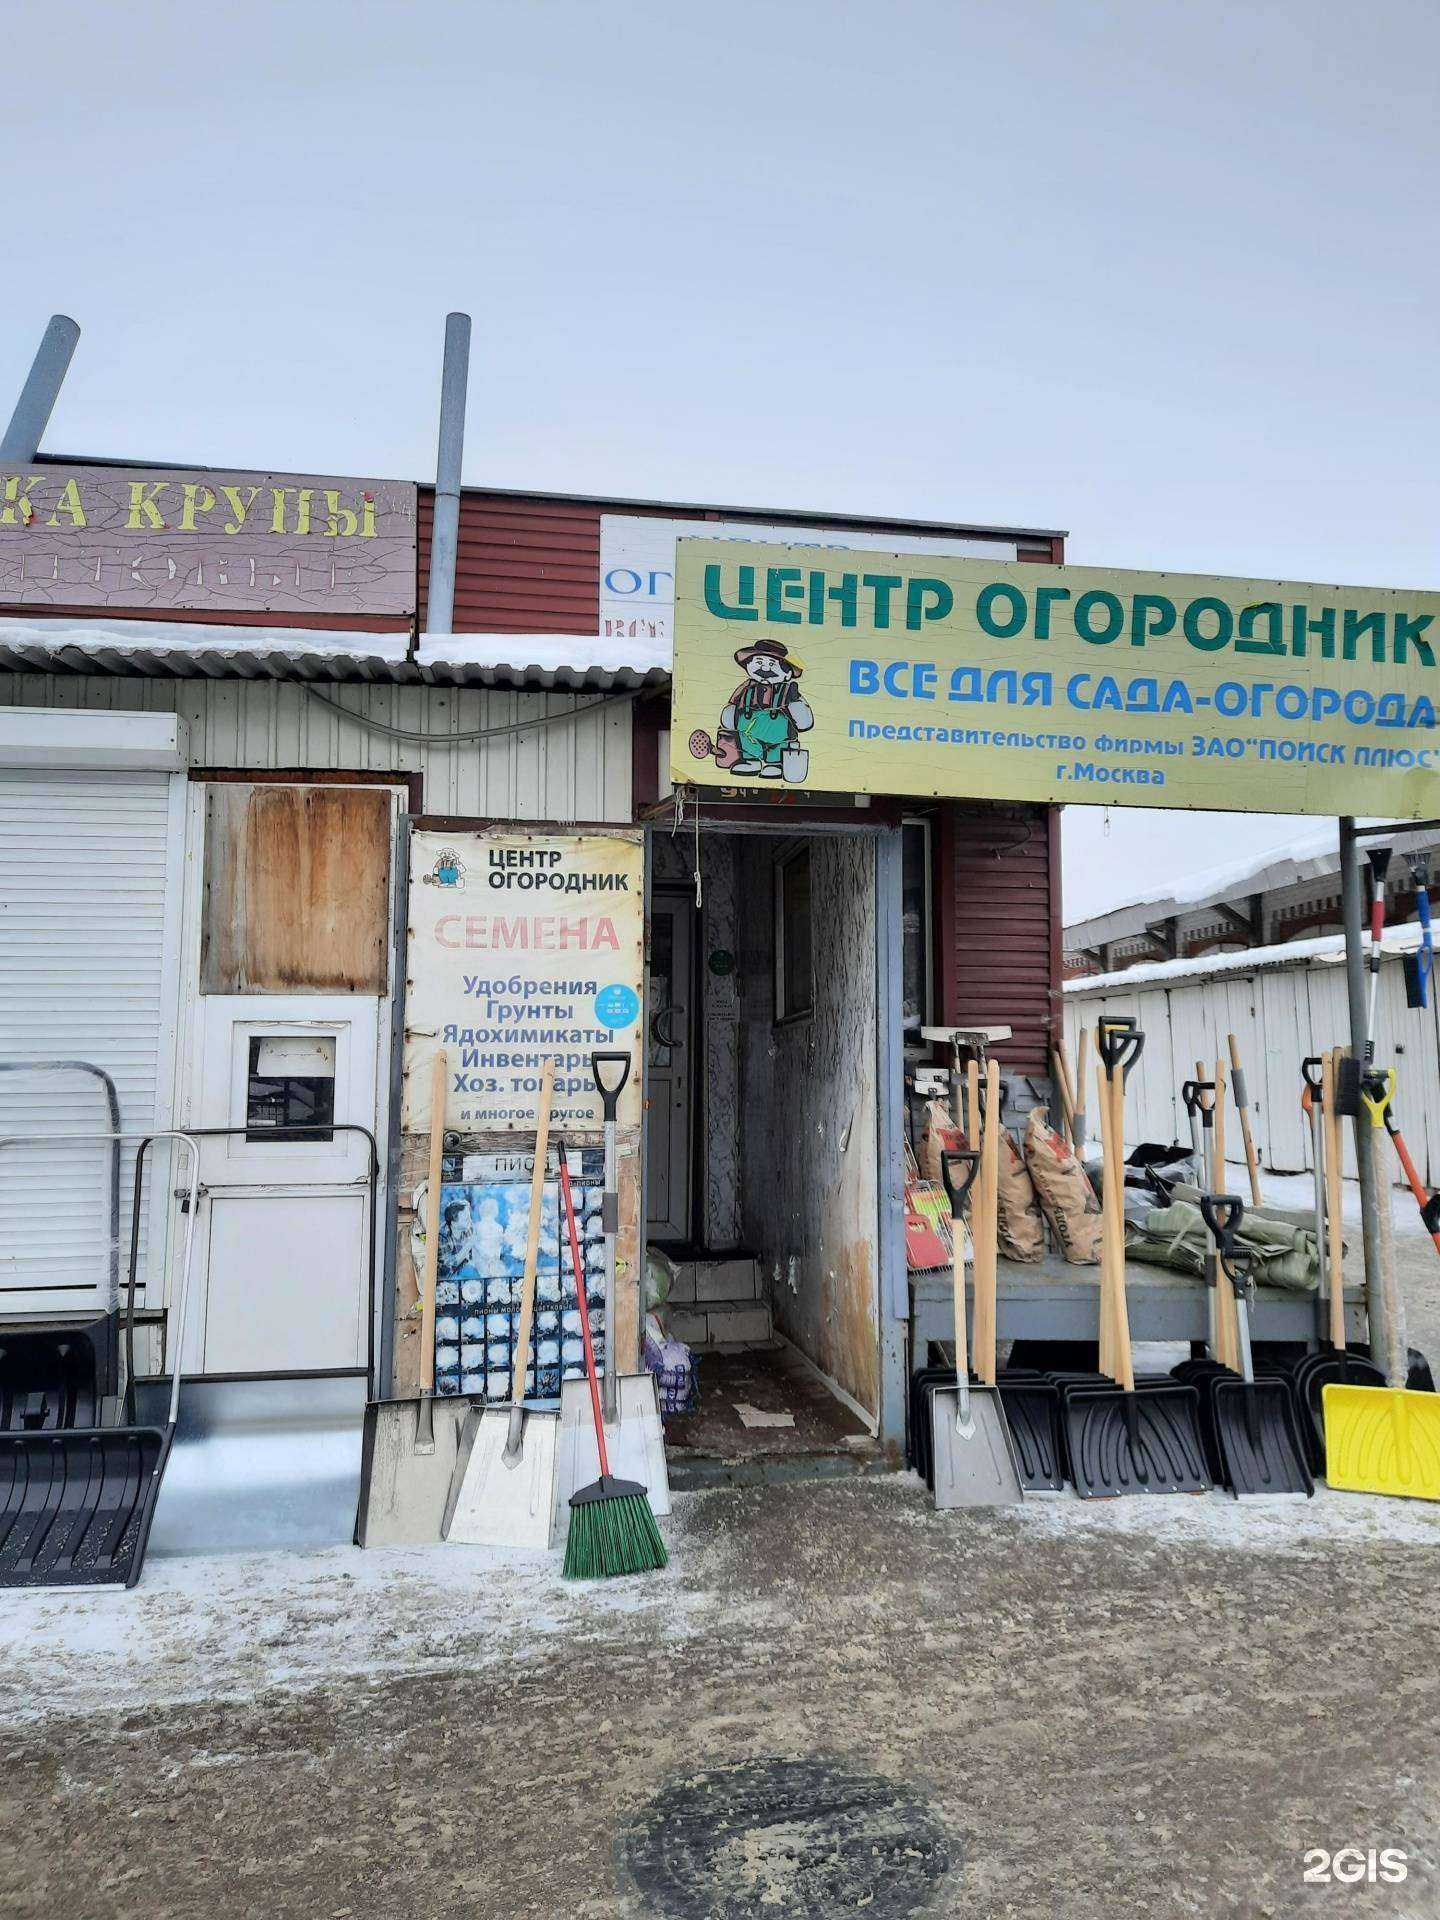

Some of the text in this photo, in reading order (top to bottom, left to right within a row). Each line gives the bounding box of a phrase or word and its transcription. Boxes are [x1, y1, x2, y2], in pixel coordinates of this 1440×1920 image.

[125, 481, 378, 539] КРУПЫ
[704, 564, 1437, 667] ЦЕНТР ОГОРОДНИК
[849, 660, 1436, 729] ВСЕ ДЛЯ САДА-ОГОРОДА
[848, 719, 1087, 750] Представительство
[1095, 733, 1184, 756] фирмы
[1056, 762, 1165, 785] г.Москва
[488, 849, 562, 870] ЦЕНТР
[488, 871, 629, 894] ОГОРОДНИК
[434, 914, 621, 951] СЕМЕНА
[462, 975, 598, 1000] Удобрения
[486, 1000, 574, 1024] Грунты
[442, 1024, 614, 1047] Ядохимикаты
[453, 1073, 598, 1097] Хоз. тоары
[460, 1108, 595, 1122] и многое ругое
